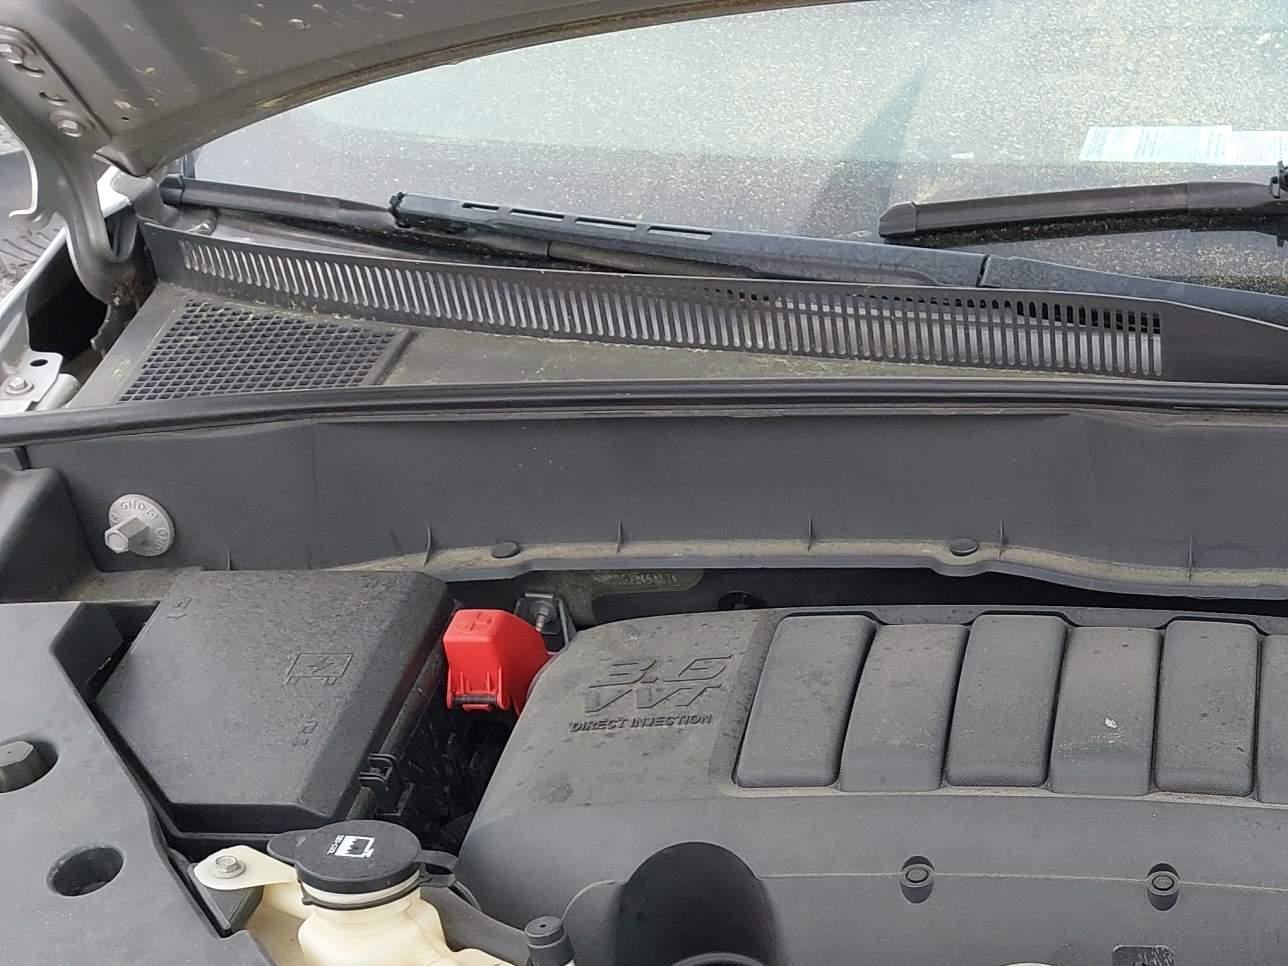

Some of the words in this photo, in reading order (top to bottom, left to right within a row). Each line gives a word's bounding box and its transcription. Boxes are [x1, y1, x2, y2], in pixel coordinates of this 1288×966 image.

[584, 684, 722, 714] VVT
[570, 717, 628, 733] DIRECT
[630, 713, 713, 730] INJECTION
